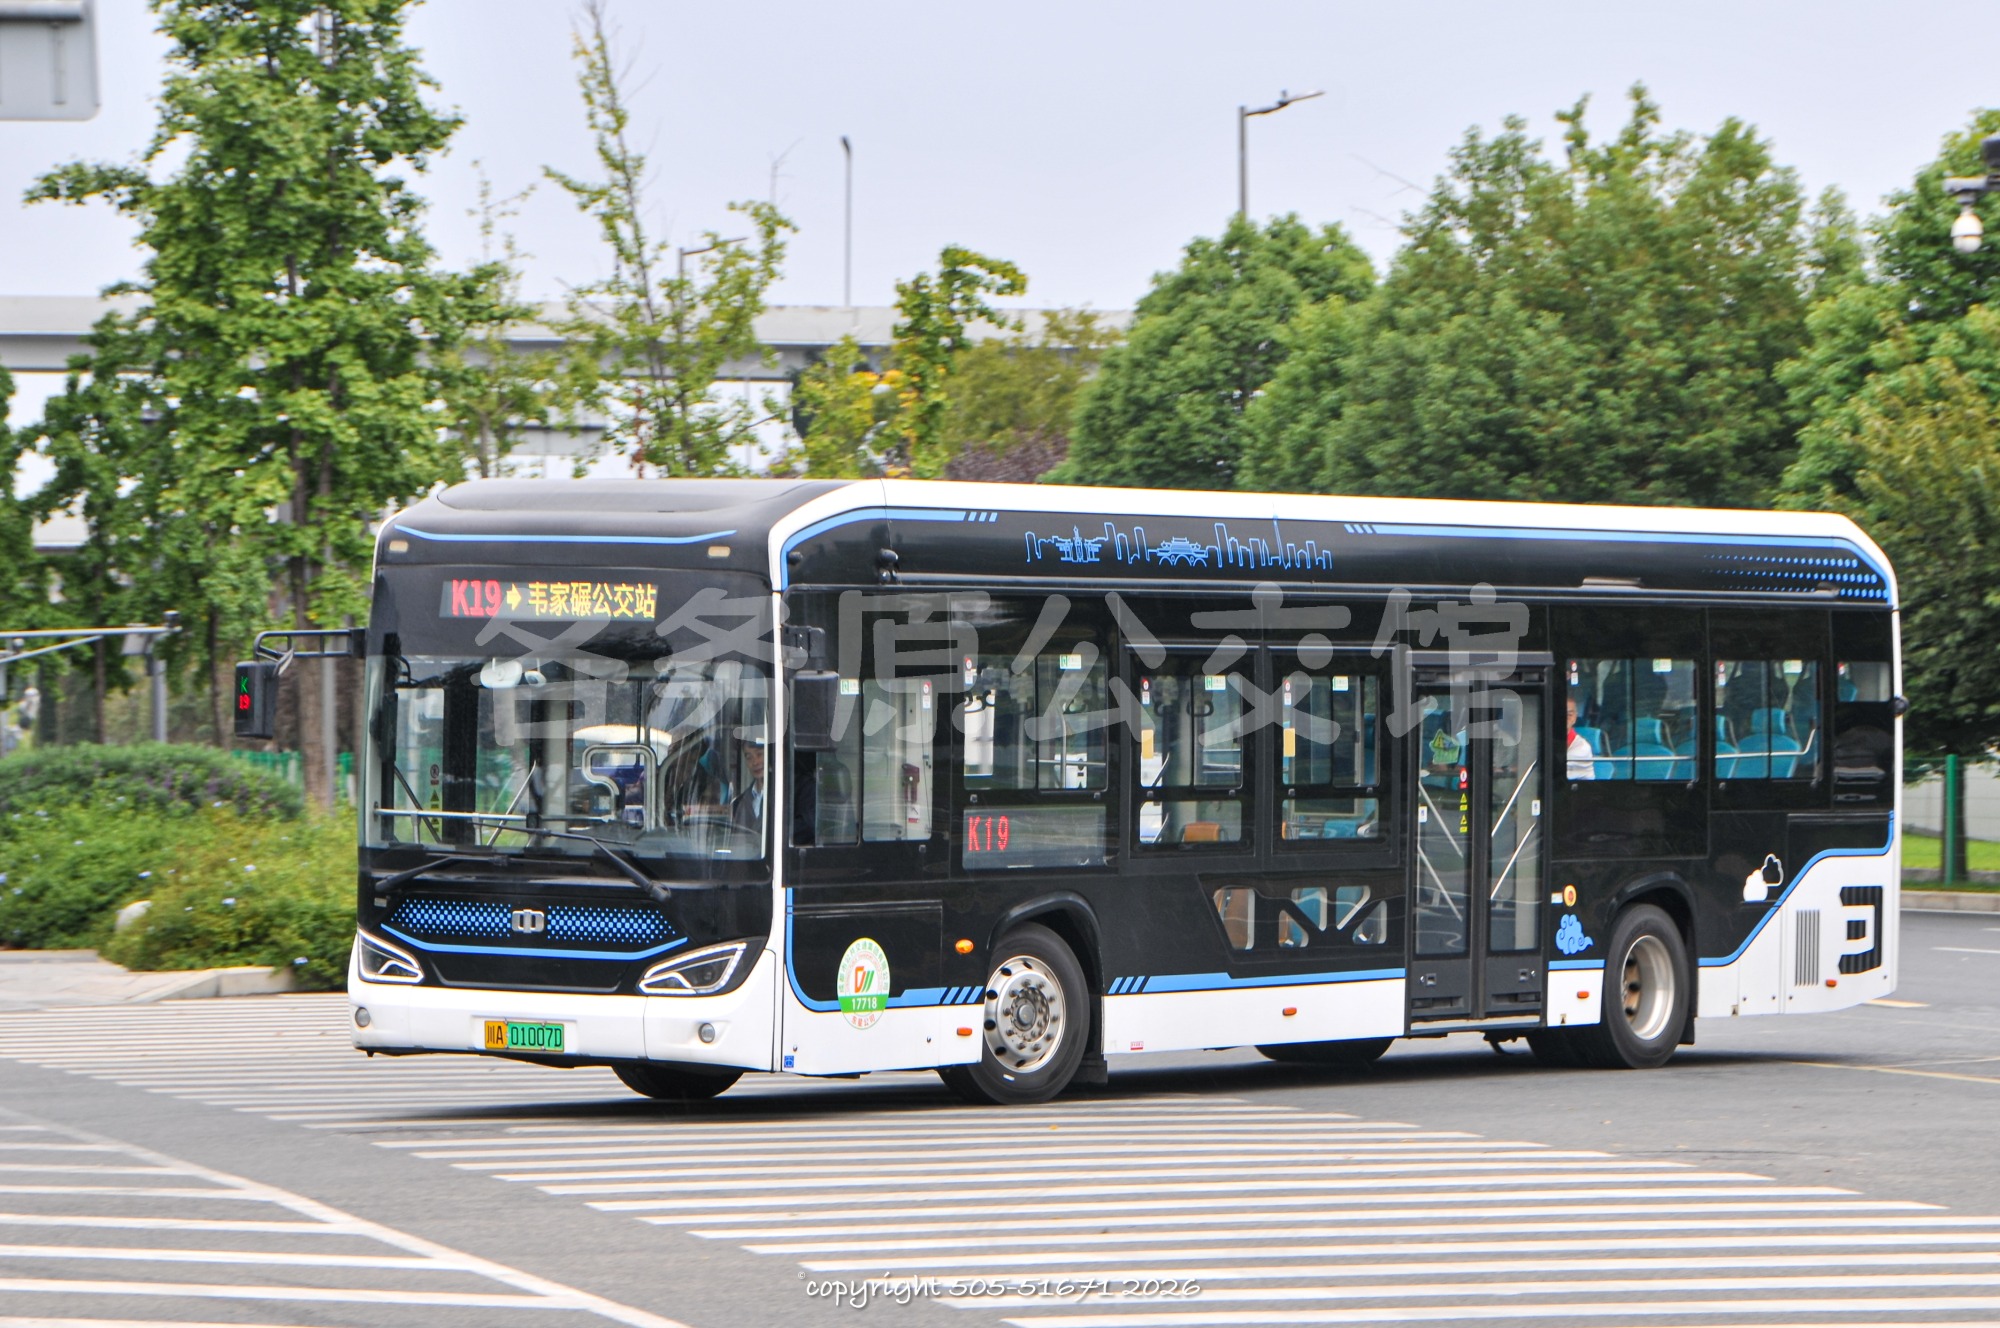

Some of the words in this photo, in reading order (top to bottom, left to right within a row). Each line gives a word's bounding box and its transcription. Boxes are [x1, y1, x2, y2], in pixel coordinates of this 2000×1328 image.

[452, 579, 502, 617] K19
[528, 581, 657, 618] 韦家碾公交站
[241, 676, 248, 693] K
[967, 815, 1010, 851] K19
[852, 997, 877, 1010] 17718
